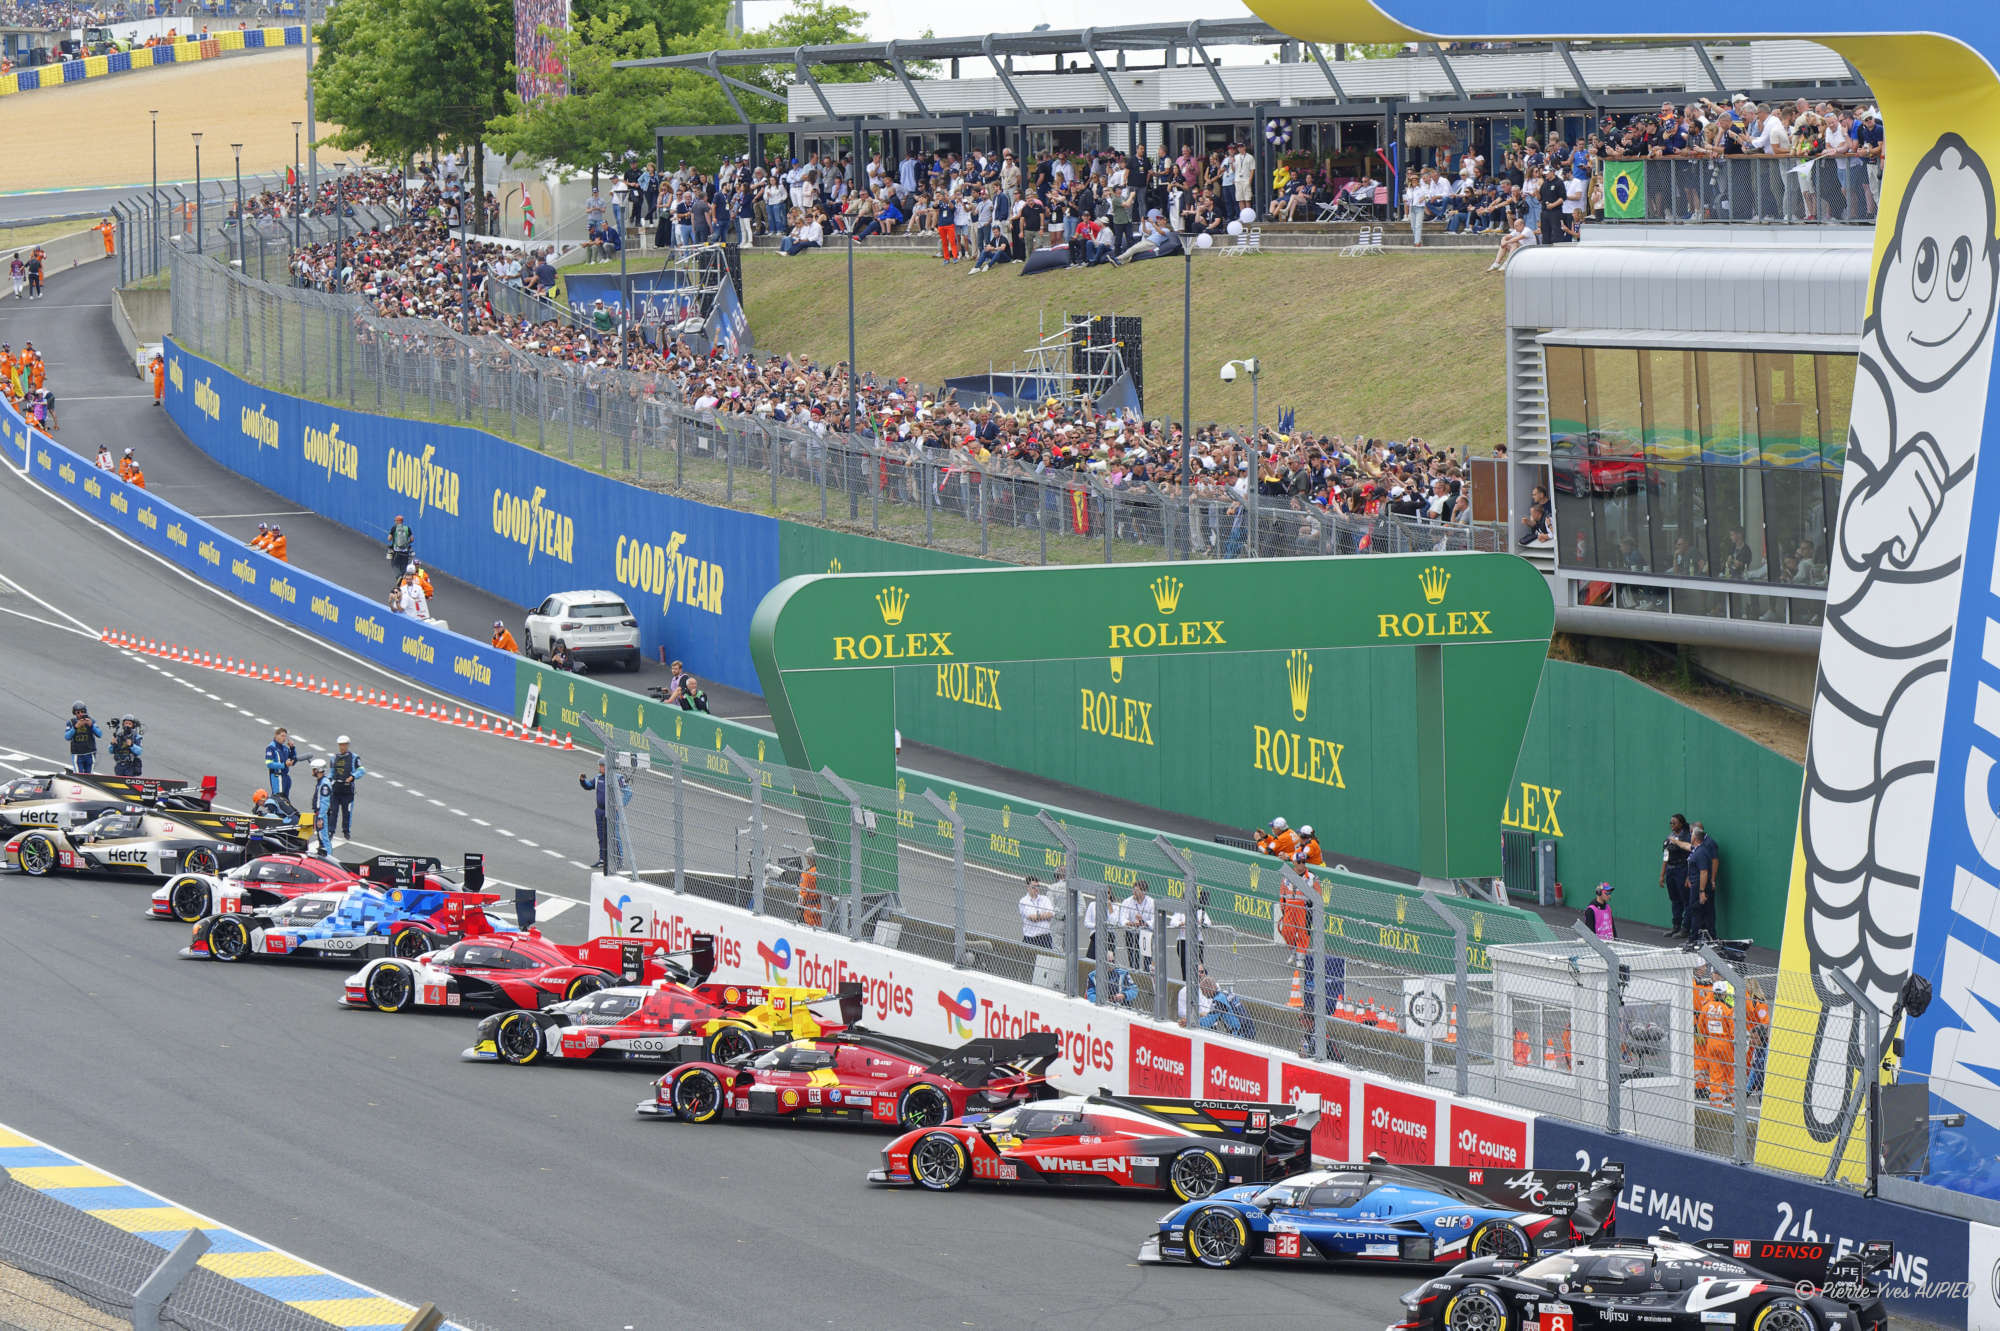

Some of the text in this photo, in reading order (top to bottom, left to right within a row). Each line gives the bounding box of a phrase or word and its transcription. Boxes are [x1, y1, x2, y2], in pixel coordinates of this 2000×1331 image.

[241, 403, 279, 451] GOODYEAR
[304, 422, 359, 482] GOODYEAR
[387, 444, 461, 519] GOODYEAR
[492, 486, 574, 566] GOODYEAR
[615, 531, 725, 616] GOODYEAR
[354, 616, 385, 644] GOODYEAR
[1108, 620, 1227, 649] ROLEX
[1377, 610, 1493, 638] ROLEX
[402, 635, 435, 665] GOODYEAR
[833, 632, 954, 661] ROLEX
[454, 655, 492, 687] GOODYEAR
[936, 663, 1002, 711] ROLEX
[1081, 687, 1155, 746] ROLEX
[707, 753, 729, 775] ROLEX
[1253, 724, 1347, 790] ROLEX
[20, 809, 59, 824] Hertz
[1502, 782, 1564, 838] LEX
[108, 848, 148, 863] Hertz
[990, 833, 1020, 858] ROLEX
[59, 851, 71, 865] 38
[359, 865, 370, 877] HY
[1105, 864, 1138, 888] ROLEX
[226, 897, 236, 912] 5
[447, 901, 458, 912] HY
[1235, 894, 1272, 920] ROLEX
[629, 916, 643, 933] 2
[1380, 927, 1420, 954] ROLEX
[578, 948, 589, 961] HY
[430, 986, 440, 1003] 4
[747, 996, 768, 1006] HEL
[774, 998, 785, 1010] HY
[629, 1039, 664, 1051] iQOO
[1153, 1055, 1185, 1077] course
[1228, 1076, 1261, 1097] course
[877, 1102, 894, 1117] 50
[1193, 1100, 1249, 1111] CADILLAC
[1319, 1098, 1342, 1117] urse
[1253, 1113, 1266, 1128] HY
[1391, 1116, 1428, 1140] course
[1220, 1144, 1246, 1155] Mobil
[1392, 1136, 1428, 1165] MANS
[1478, 1138, 1517, 1163] course
[973, 1156, 998, 1177] 311
[1035, 1155, 1127, 1173] WHELEN
[1469, 1171, 1482, 1183] HY
[1616, 1184, 1714, 1231] LE MANS
[1434, 1215, 1460, 1228] elf
[1278, 1235, 1298, 1255] 36
[1332, 1231, 1398, 1241] ALPINE
[1734, 1242, 1824, 1260] HY DENSO
[1550, 1316, 1564, 1331] 8
[1599, 1309, 1629, 1323] FUJITSU
